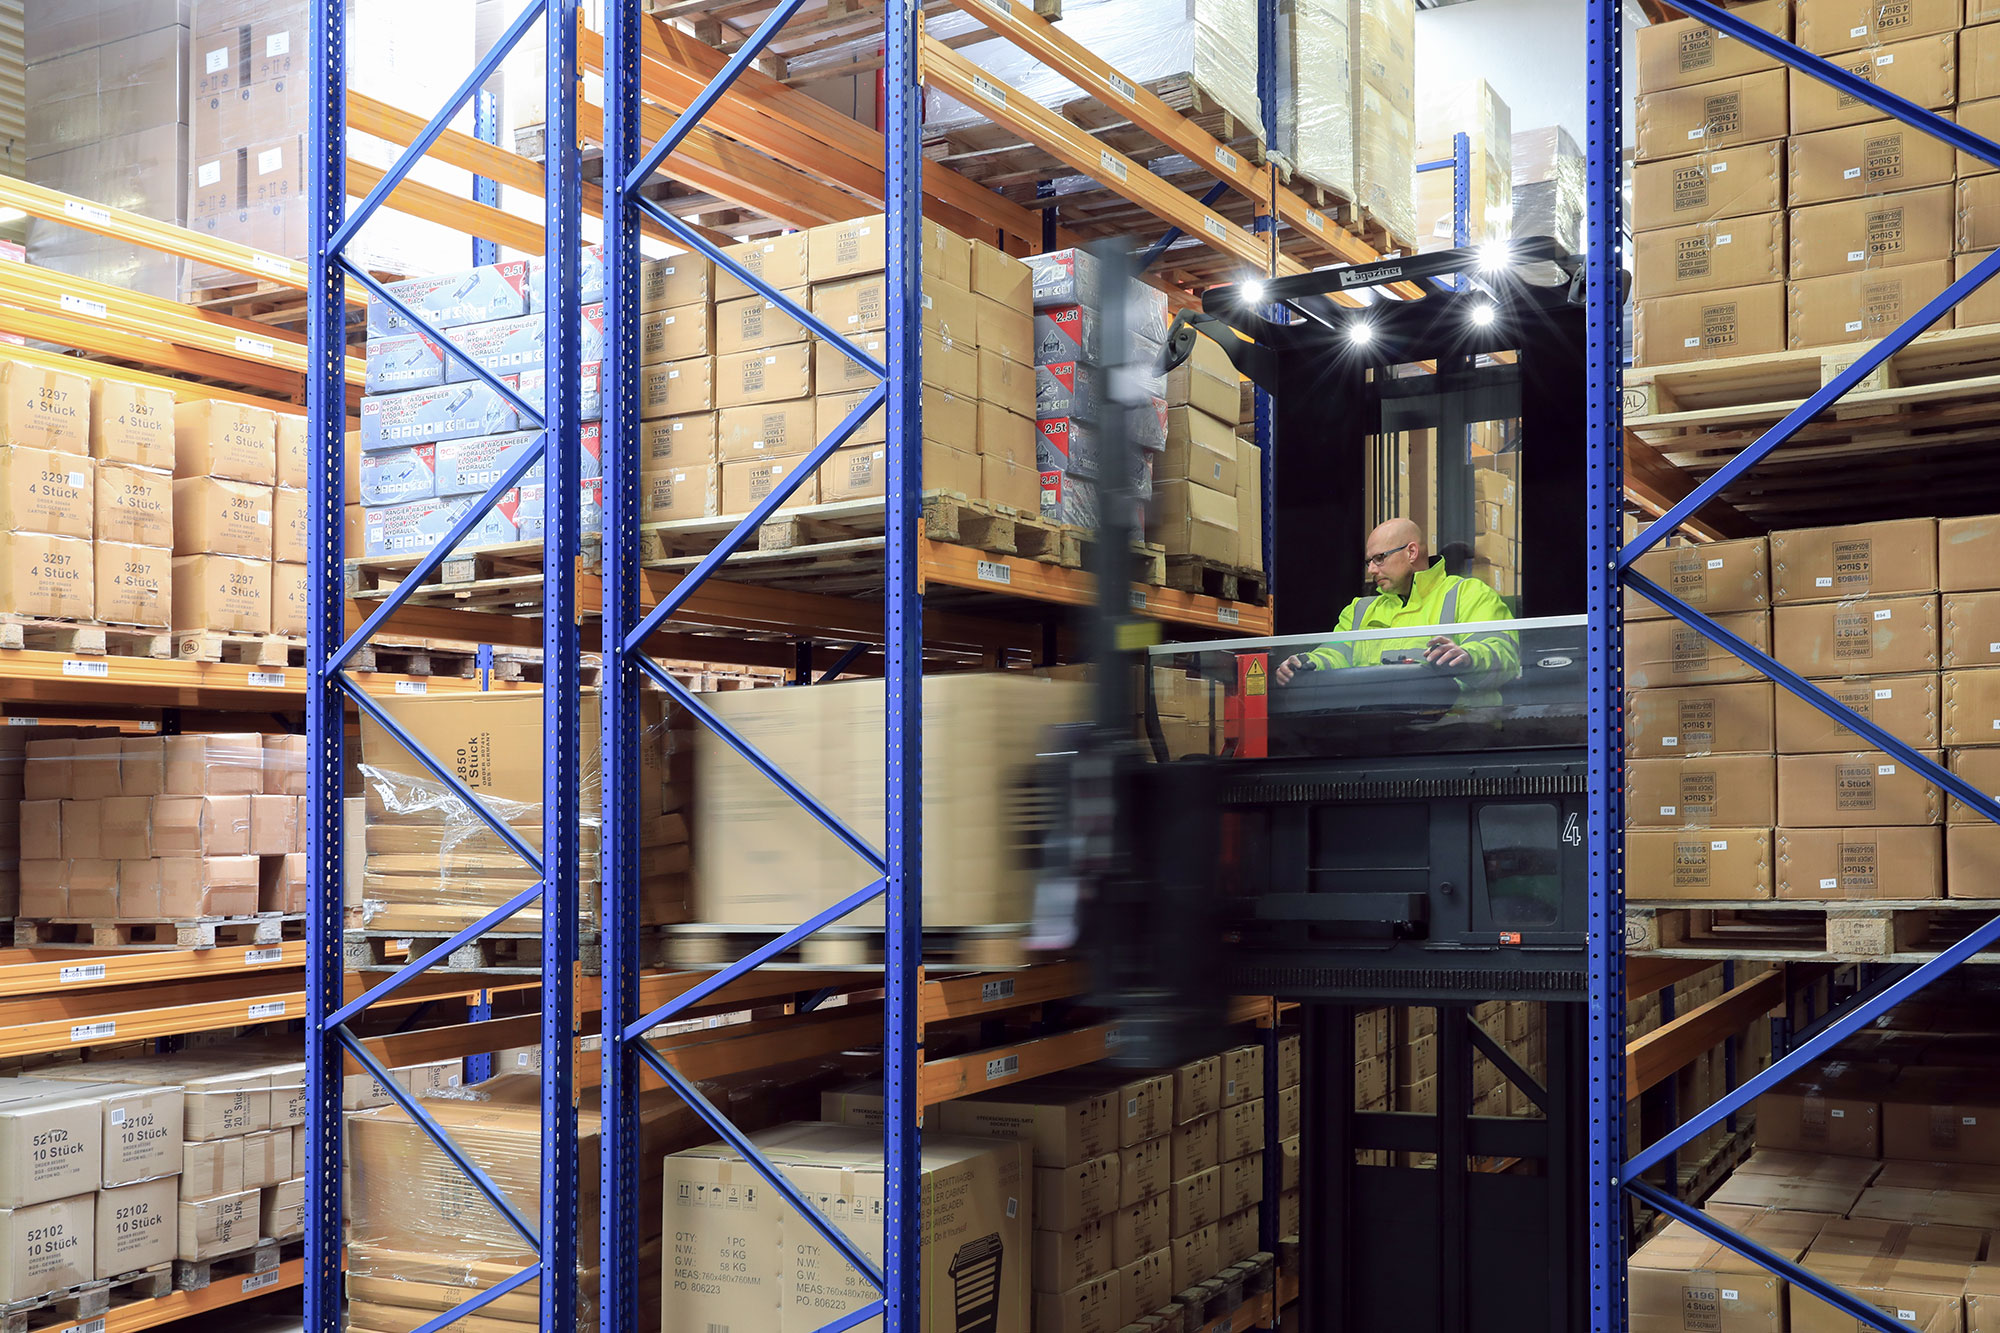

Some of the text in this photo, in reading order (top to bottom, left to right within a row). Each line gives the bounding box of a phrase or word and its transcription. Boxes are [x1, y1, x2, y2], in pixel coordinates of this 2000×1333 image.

[1878, 16, 1908, 28] 1196
[1682, 30, 1710, 42] 1196
[1689, 40, 1710, 51] Stück
[1710, 114, 1730, 123] Stück
[1710, 124, 1737, 134] 1196
[1870, 156, 1892, 166] Stück
[1870, 167, 1900, 178] 1196
[1684, 180, 1704, 189] Stück
[1870, 231, 1894, 240] Stück
[1872, 242, 1900, 252] 1196
[1686, 250, 1706, 258] Stück
[504, 266, 523, 276] 2.5t
[1339, 266, 1402, 286] Magaziner
[1868, 303, 1891, 312] Stück
[1056, 311, 1078, 322] 2.5t
[1706, 324, 1728, 333] Stück
[1707, 335, 1734, 344] 1196
[1055, 366, 1072, 374] 2.5t
[39, 387, 68, 402] 3297
[27, 400, 76, 416] 4 Stück
[129, 403, 154, 416] 3297
[118, 416, 162, 430] 4 Stück
[233, 422, 256, 434] 3297
[1046, 422, 1066, 434] 2.5t
[224, 434, 230, 442] 4
[41, 471, 70, 484] 3297
[1042, 476, 1058, 484] 2.5t
[29, 484, 78, 499] 4 Stück
[125, 485, 152, 496] 3297
[117, 496, 160, 510] 4 Stück
[231, 498, 254, 508] 3297
[222, 510, 228, 518] 4
[43, 553, 71, 565] 3297
[31, 566, 79, 580] 4 Stück
[124, 563, 150, 574] 3297
[1838, 563, 1860, 571] Stück
[114, 576, 158, 588] 4 Stück
[230, 573, 254, 584] 3297
[1681, 574, 1702, 583] Stück
[220, 584, 260, 598] 4 Stück
[1844, 628, 1868, 637] Stück
[1682, 722, 1704, 730] Stück
[468, 737, 479, 778] Stück
[456, 748, 467, 782] 2850
[1847, 780, 1872, 788] Stück
[1562, 812, 1581, 846] 4
[289, 1098, 298, 1118] 9475
[122, 1113, 154, 1130] 52102
[224, 1109, 232, 1128] 9475
[234, 1118, 242, 1127] 20
[33, 1130, 68, 1146] 52102
[122, 1127, 168, 1144] 10 Stück
[34, 1142, 84, 1162] 10 Stück
[116, 1203, 148, 1220] 52102
[234, 1200, 242, 1220] 9475
[116, 1214, 162, 1234] 10 Stück
[222, 1204, 233, 1244] 20 Stück
[28, 1224, 63, 1242] 52102
[28, 1236, 78, 1256] 10 Stück
[732, 1238, 746, 1248] PC
[720, 1248, 730, 1258] 55
[732, 1250, 746, 1260] KG
[720, 1262, 730, 1271] 58
[732, 1263, 746, 1272] KG
[846, 1277, 856, 1286] 58
[691, 1282, 720, 1294] 806223
[1686, 1290, 1714, 1300] 1196
[814, 1298, 846, 1310] 806223
[1693, 1302, 1716, 1311] Stück
